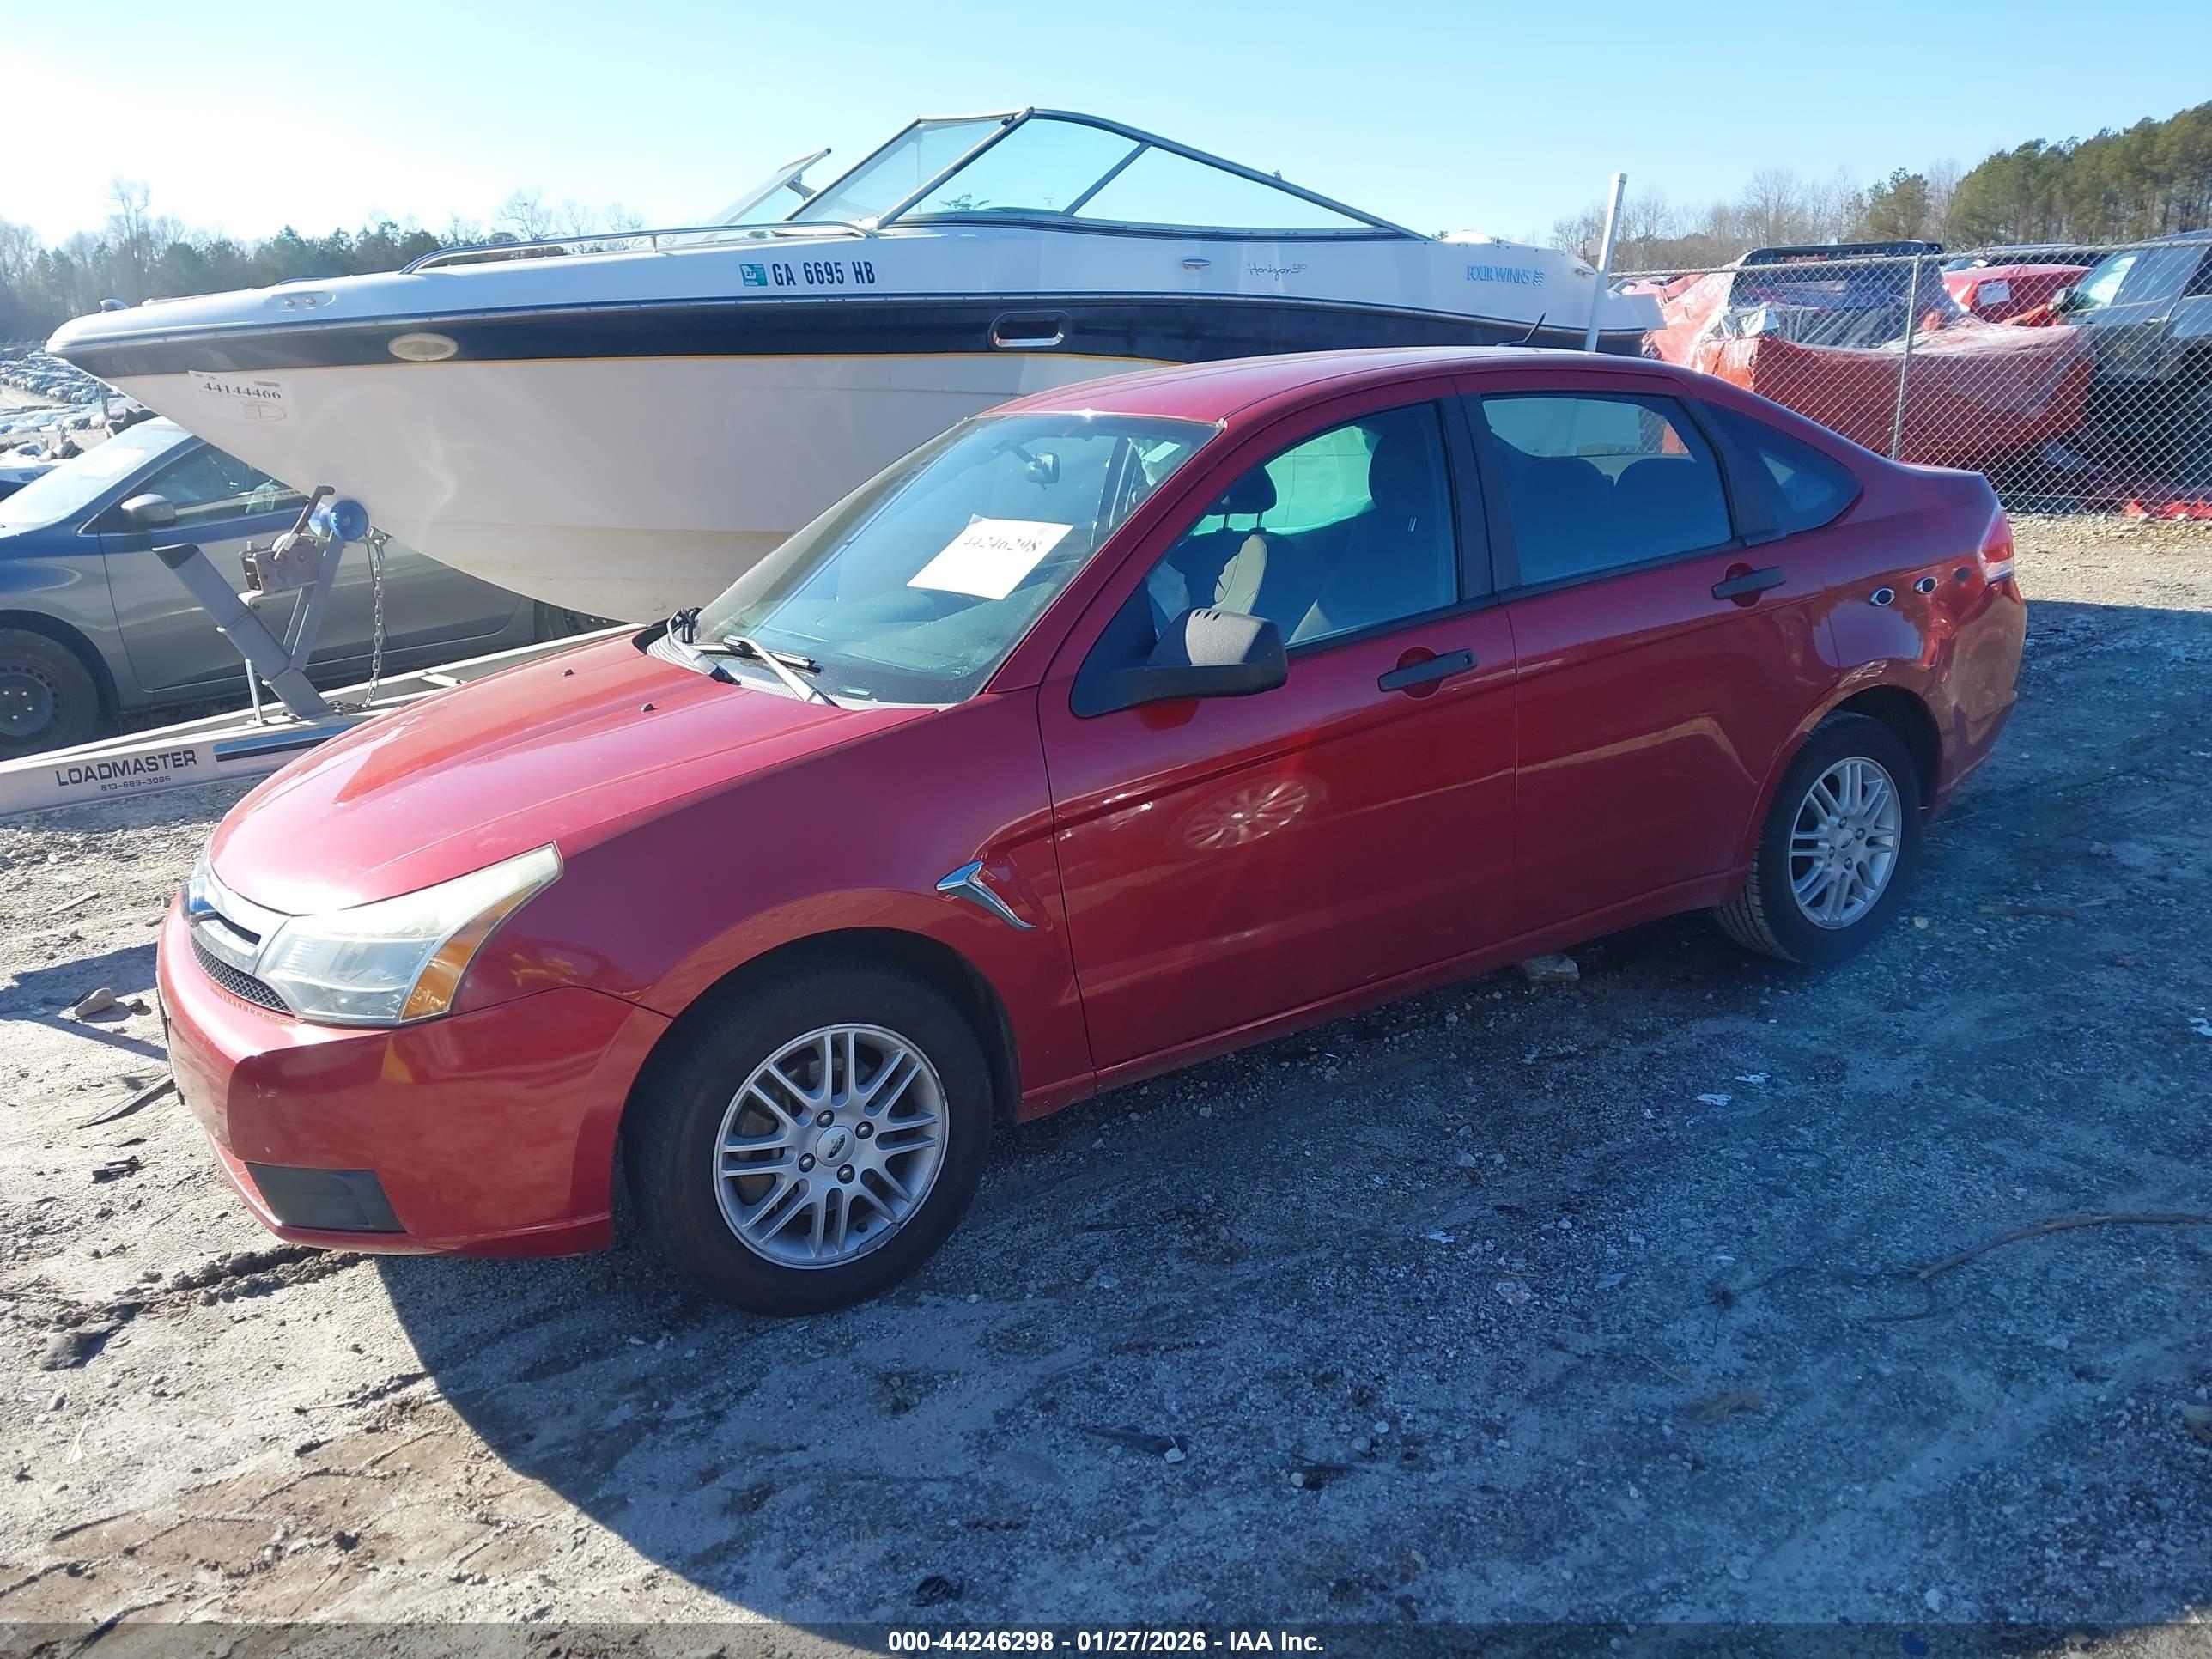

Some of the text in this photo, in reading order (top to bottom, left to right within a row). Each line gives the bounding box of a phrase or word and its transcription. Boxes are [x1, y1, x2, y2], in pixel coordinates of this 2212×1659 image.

[772, 261, 876, 286] GA 6695 HB
[1247, 263, 1300, 282] Horizon
[203, 382, 282, 399] 44144466
[55, 749, 198, 787] LOADMASTER
